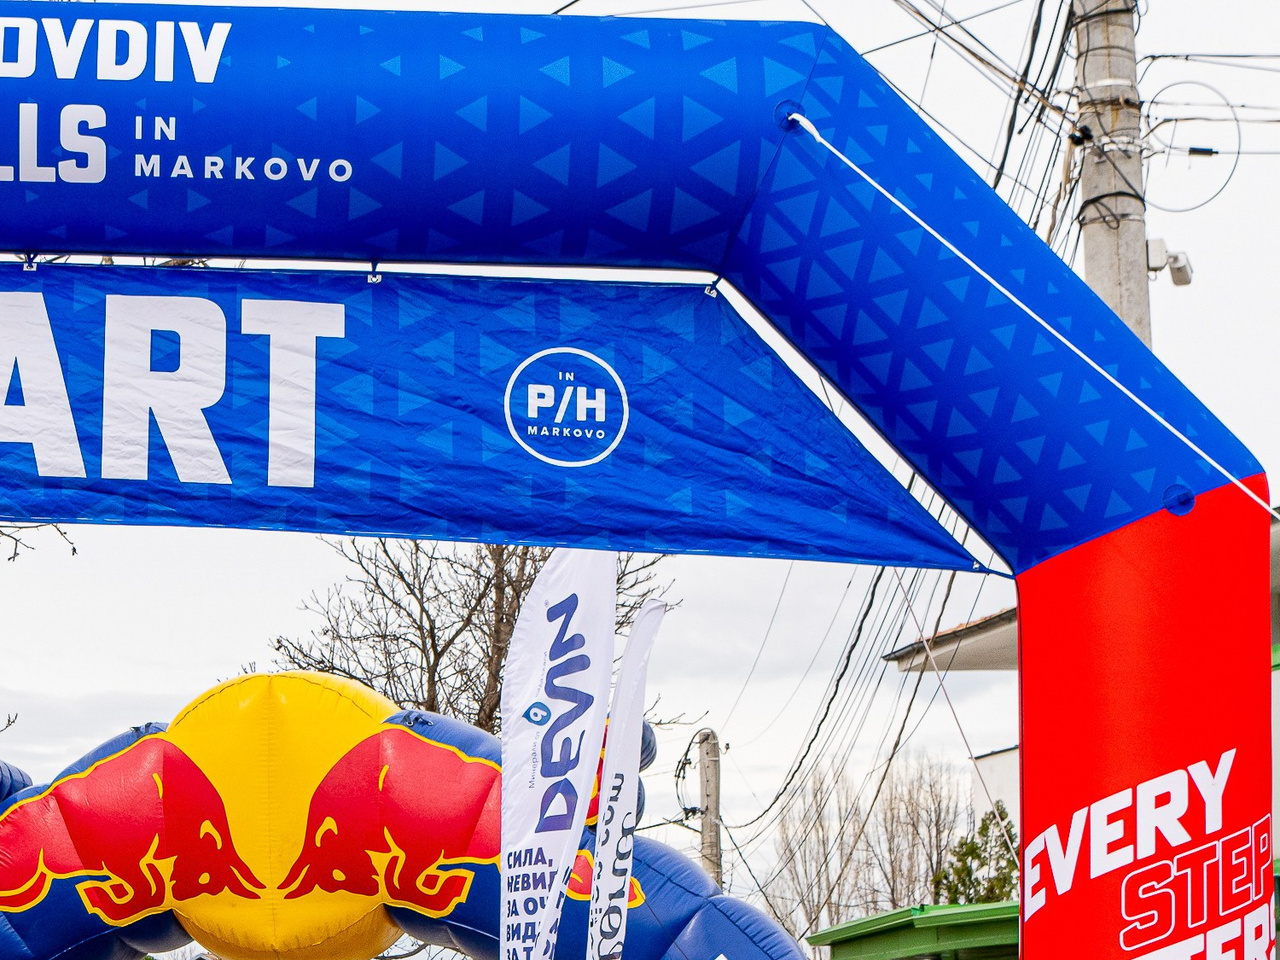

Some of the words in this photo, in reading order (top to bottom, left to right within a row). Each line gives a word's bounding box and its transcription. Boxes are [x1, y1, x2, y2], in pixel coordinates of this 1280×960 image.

[135, 116, 176, 140] IN
[135, 154, 353, 183] MARKOVO
[558, 372, 574, 381] IN
[527, 384, 606, 423] P/H
[527, 426, 606, 439] MARKOVO
[535, 593, 595, 833] DEVIN
[1025, 748, 1236, 922] EVERY
[507, 847, 553, 869] СИЛА,
[1120, 813, 1271, 951] STEP
